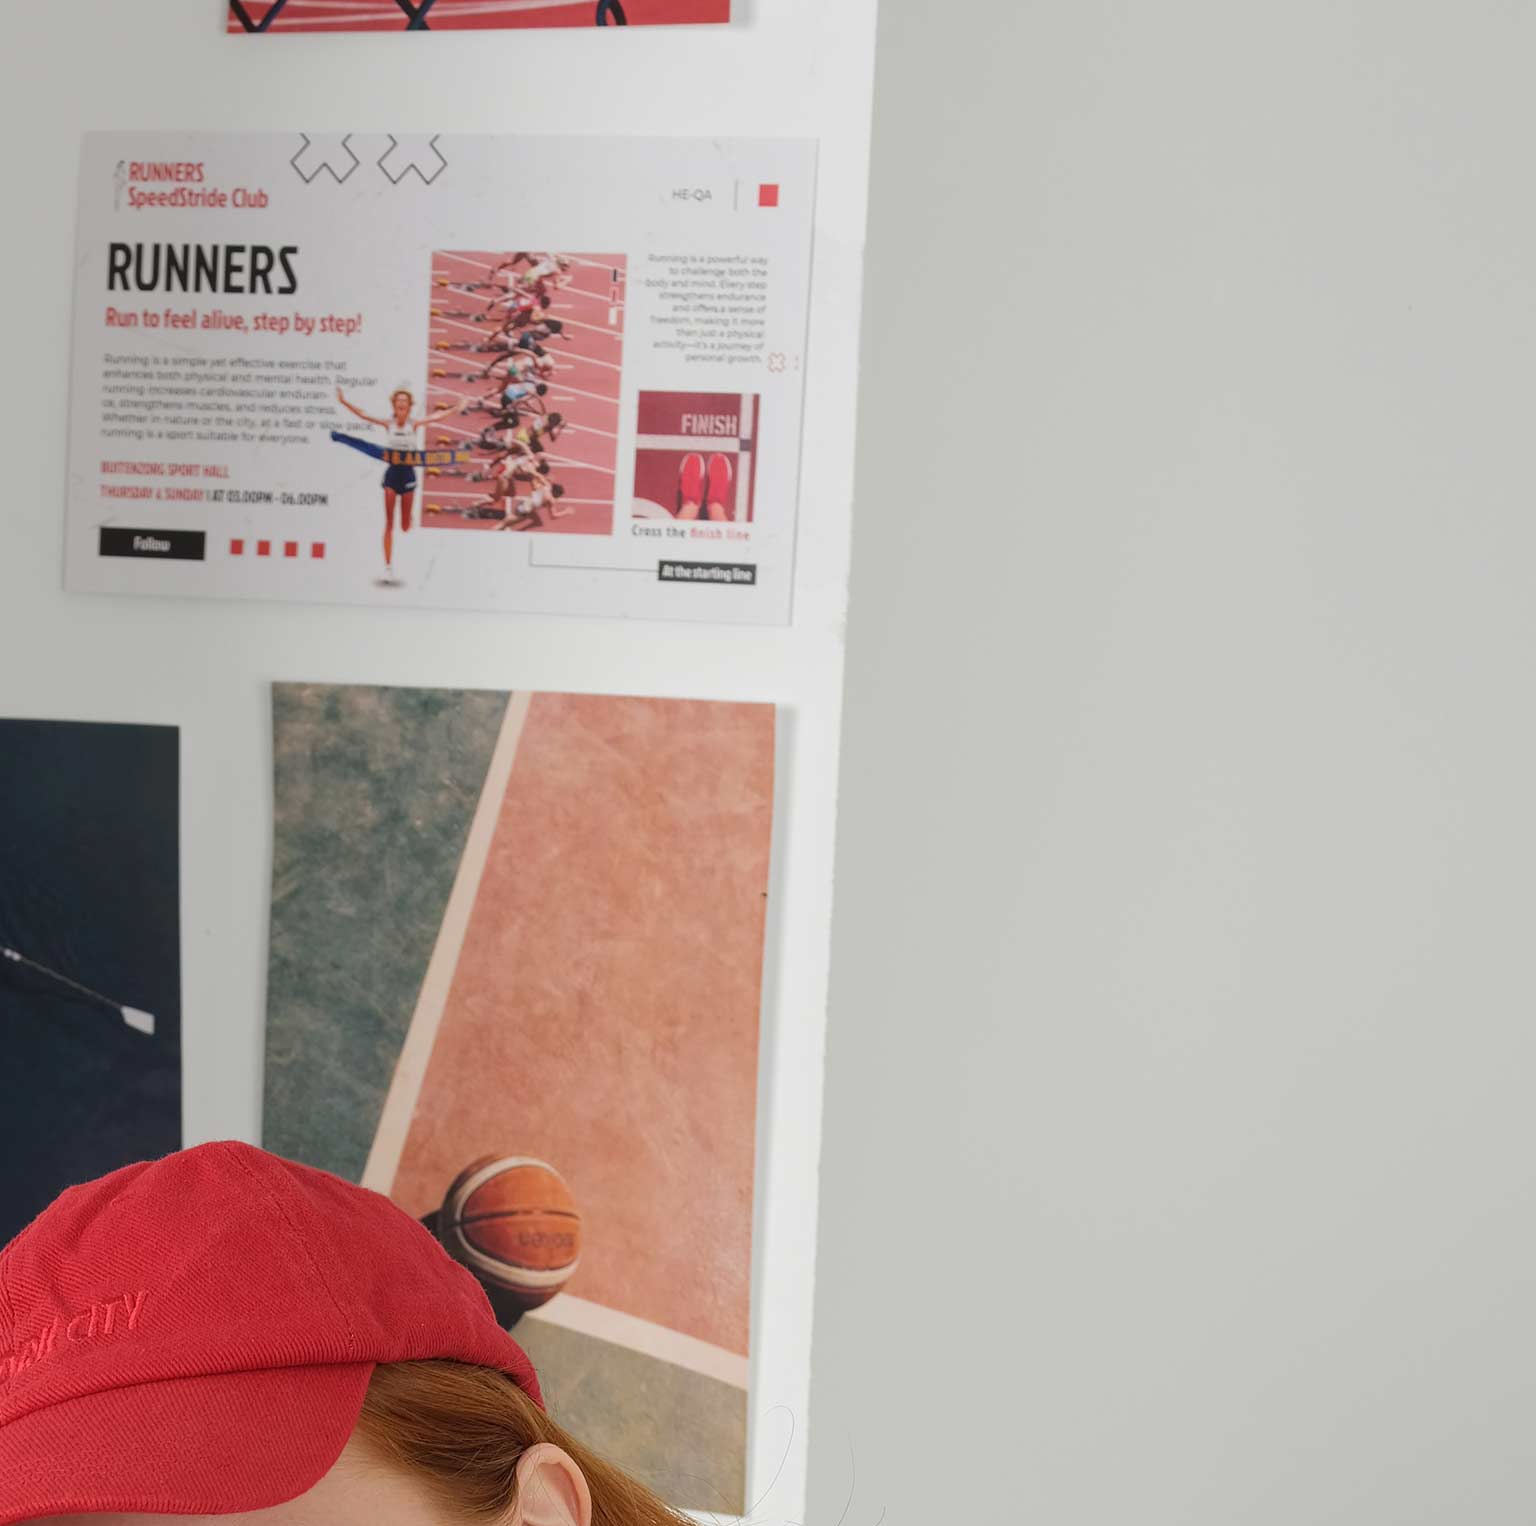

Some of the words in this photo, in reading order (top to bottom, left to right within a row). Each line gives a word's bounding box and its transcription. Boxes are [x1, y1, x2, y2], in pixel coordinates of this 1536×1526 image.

[129, 162, 204, 183] RUNNERS
[128, 186, 227, 210] SpeedStride
[232, 188, 269, 208] Club
[672, 188, 712, 202] HE-QA
[107, 242, 298, 295] RUNNERS
[105, 307, 138, 327] Run
[143, 310, 160, 327] to
[164, 309, 196, 329] feel
[201, 311, 248, 334] alive,
[253, 313, 289, 333] step
[294, 313, 316, 334] by
[320, 313, 362, 336] step!
[681, 414, 737, 435] FINISH
[168, 464, 200, 477] SPORT
[203, 465, 230, 479] HALL
[165, 487, 203, 500] SUNDAY
[631, 525, 662, 537] Cross
[666, 526, 686, 538] the
[133, 536, 171, 552] Follow
[675, 565, 691, 577] the
[692, 567, 732, 581] starting
[733, 568, 752, 581] line
